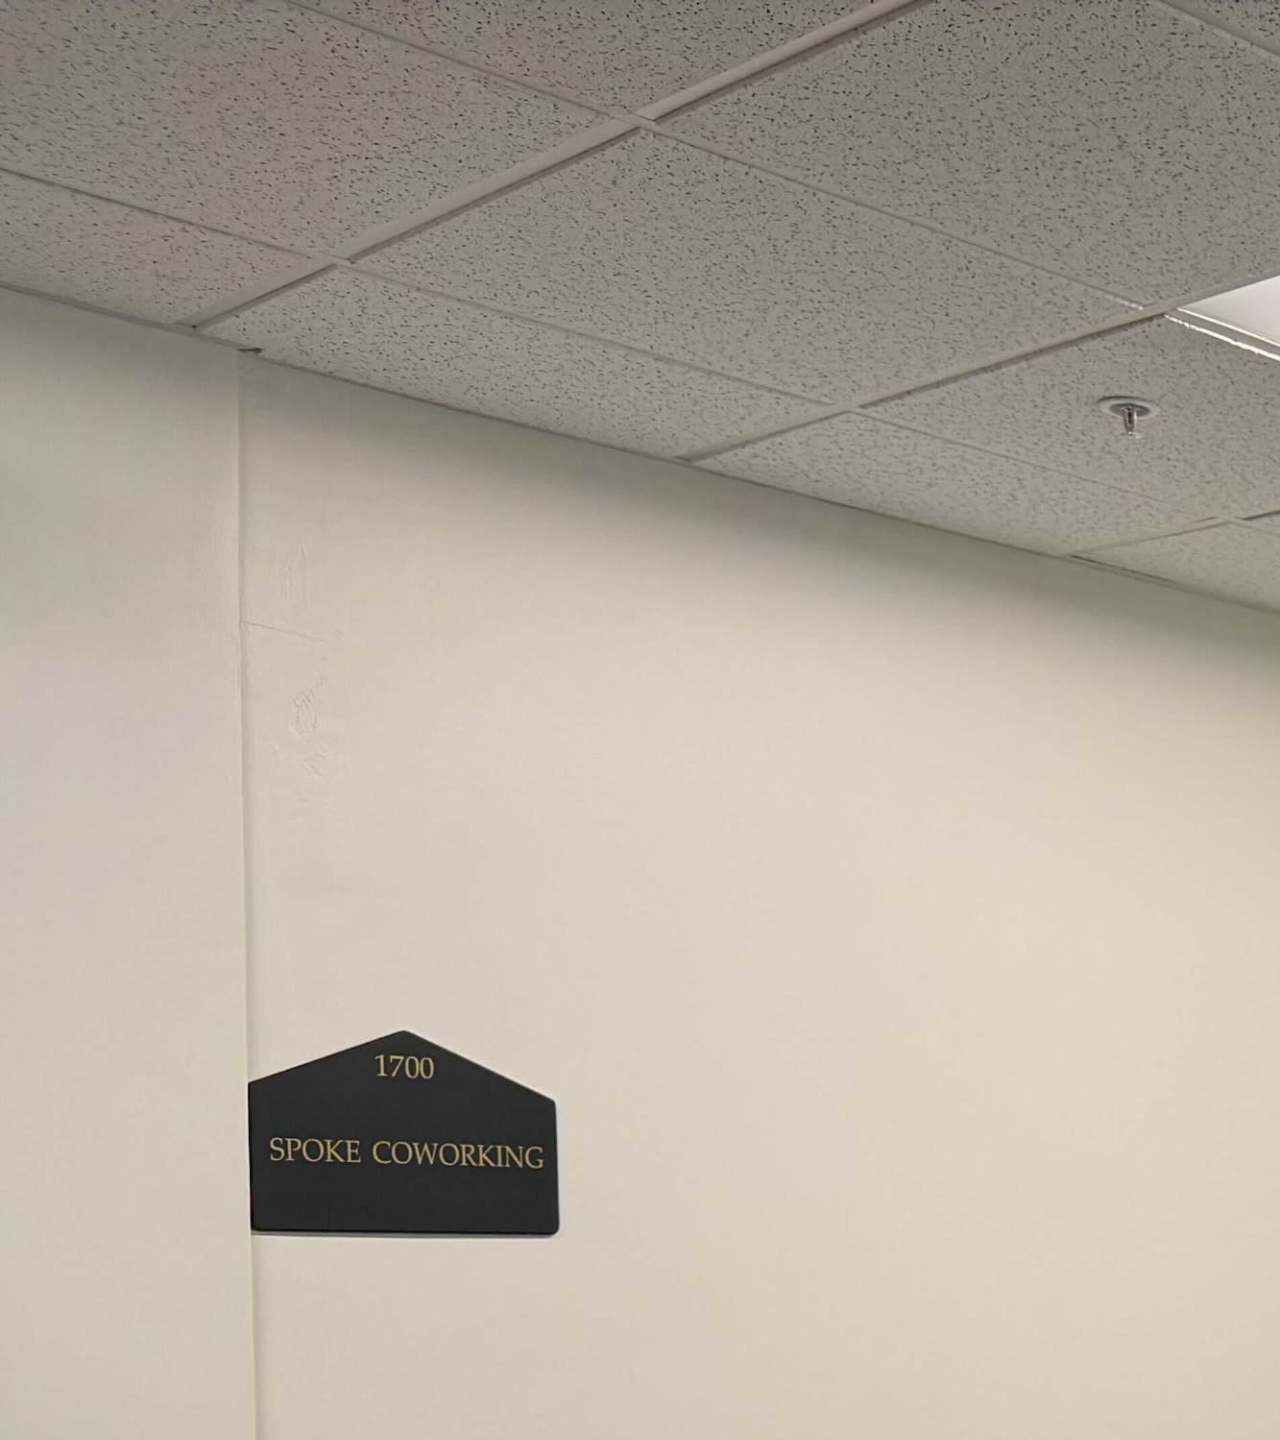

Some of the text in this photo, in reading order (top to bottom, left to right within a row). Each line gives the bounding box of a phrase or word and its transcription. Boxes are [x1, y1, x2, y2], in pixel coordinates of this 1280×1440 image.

[375, 1054, 434, 1079] 1700
[269, 1137, 544, 1169] SPOKE COWORKING
